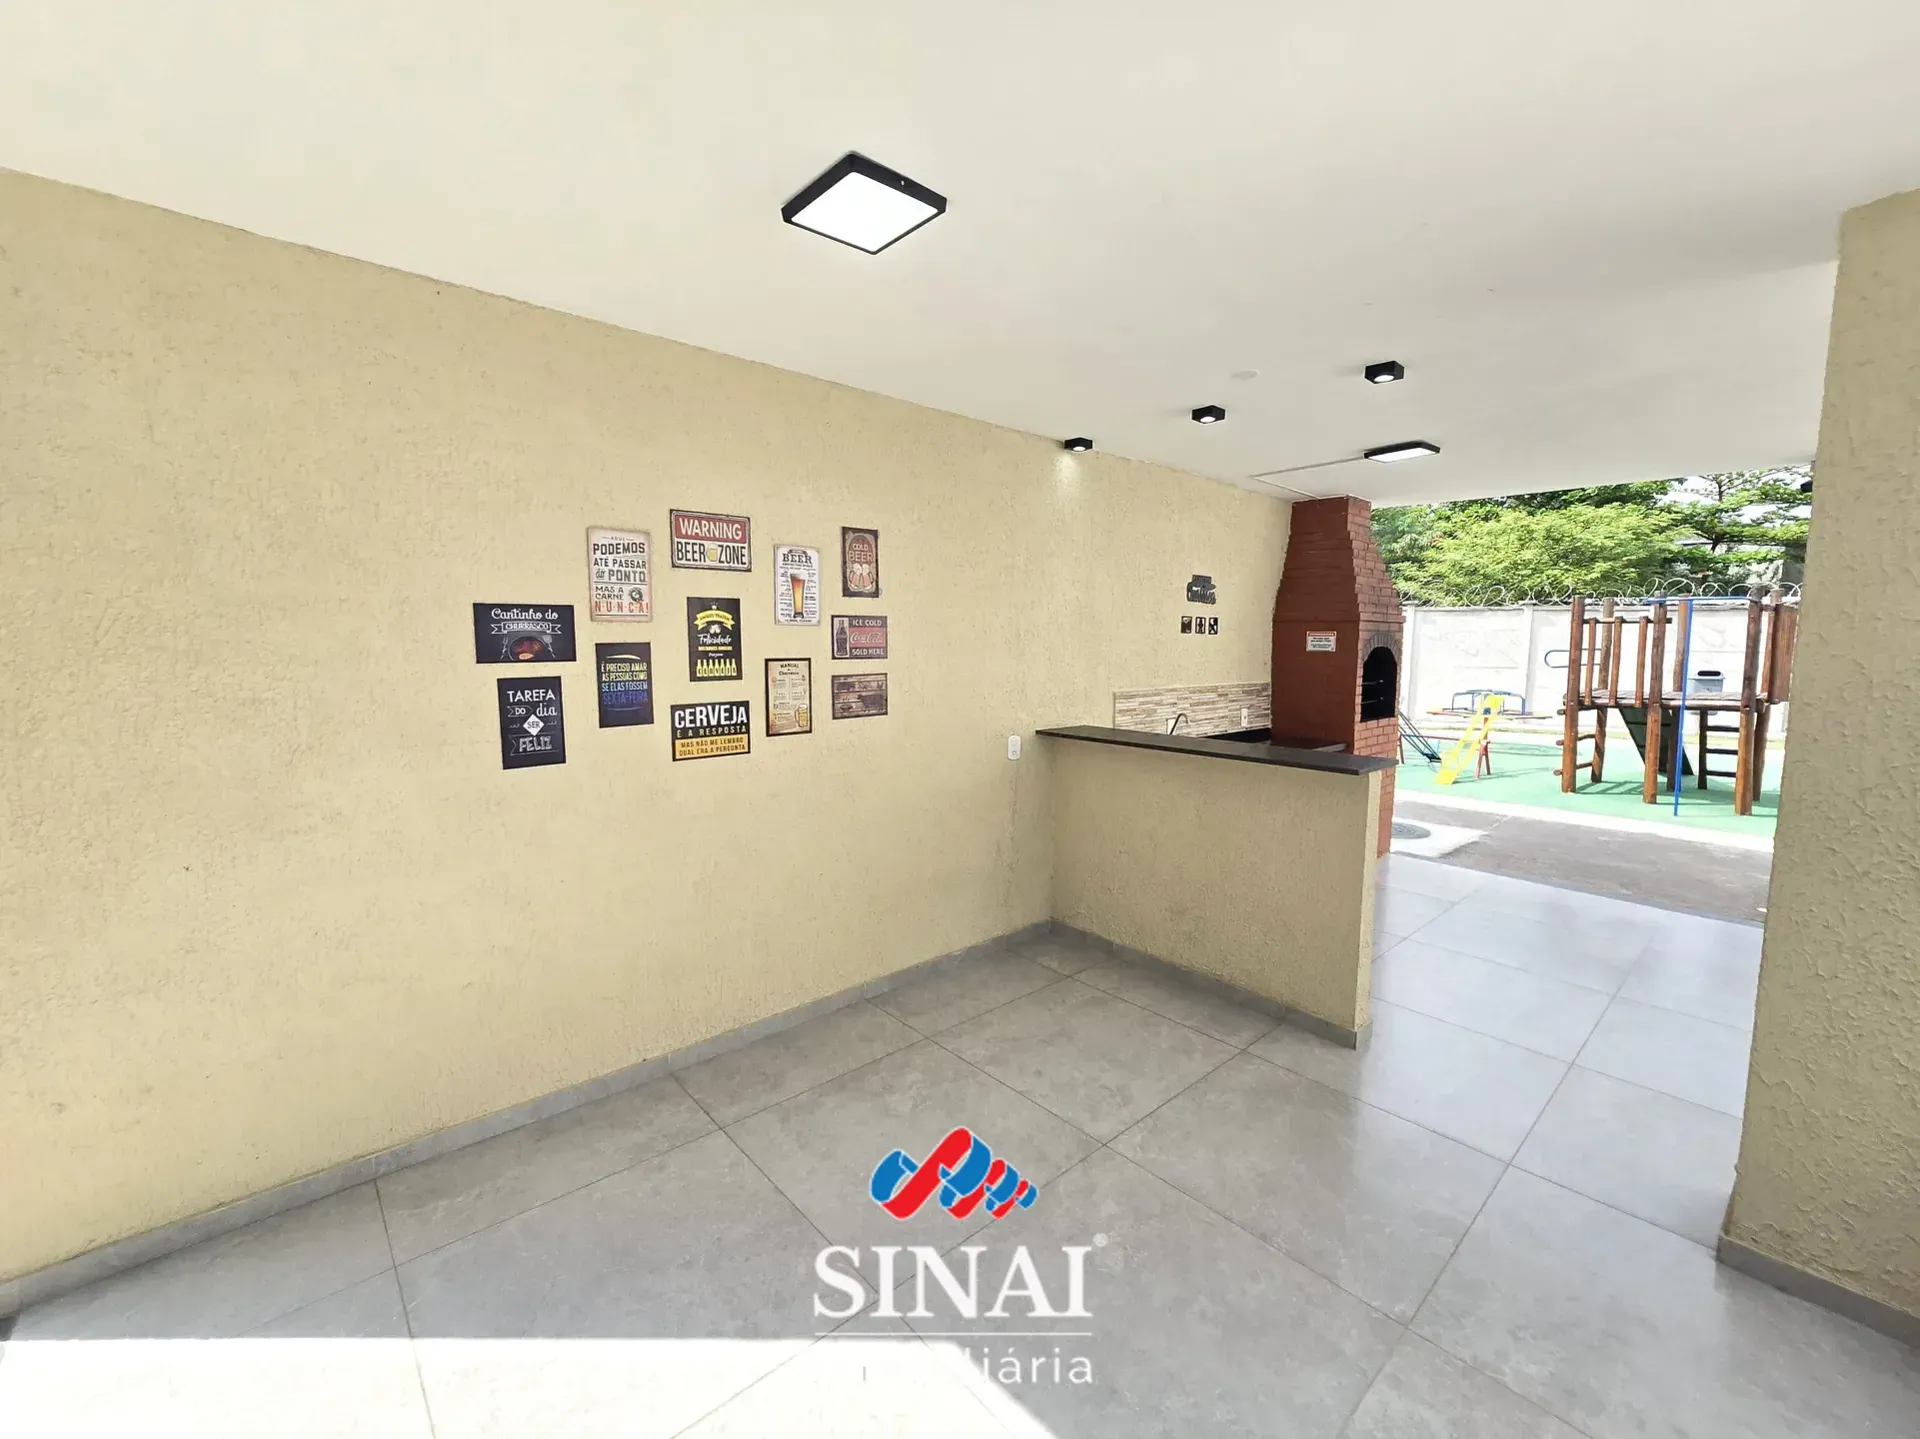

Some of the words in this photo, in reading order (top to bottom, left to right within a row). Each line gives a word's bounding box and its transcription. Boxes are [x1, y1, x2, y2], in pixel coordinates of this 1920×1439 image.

[679, 518, 742, 540] WARNING
[593, 542, 646, 555] PODEMOS
[676, 541, 706, 563] BEER
[718, 544, 746, 566] ZONE
[782, 553, 812, 564] BEER
[849, 551, 872, 562] BEER
[594, 556, 610, 567] ATÉ
[612, 558, 646, 570] PASSAR
[608, 570, 646, 582] PONTO
[491, 608, 542, 620] Cantinho
[544, 608, 558, 620] do
[606, 662, 630, 672] PRECISO
[632, 662, 647, 671] AMAR
[610, 672, 632, 681] PESSOAS
[634, 672, 647, 680] COMO
[602, 682, 610, 691] SE
[610, 682, 624, 691] ELAS
[626, 682, 648, 690] FOSSEM
[506, 688, 556, 702] TAREFA
[536, 702, 558, 716] dia
[675, 705, 748, 728] CERVEJA
[527, 721, 540, 729] SER
[677, 730, 682, 738] É
[700, 726, 746, 736] RESPOSTA
[519, 736, 552, 752] FELIZ
[716, 744, 746, 752] PERGUNTA
